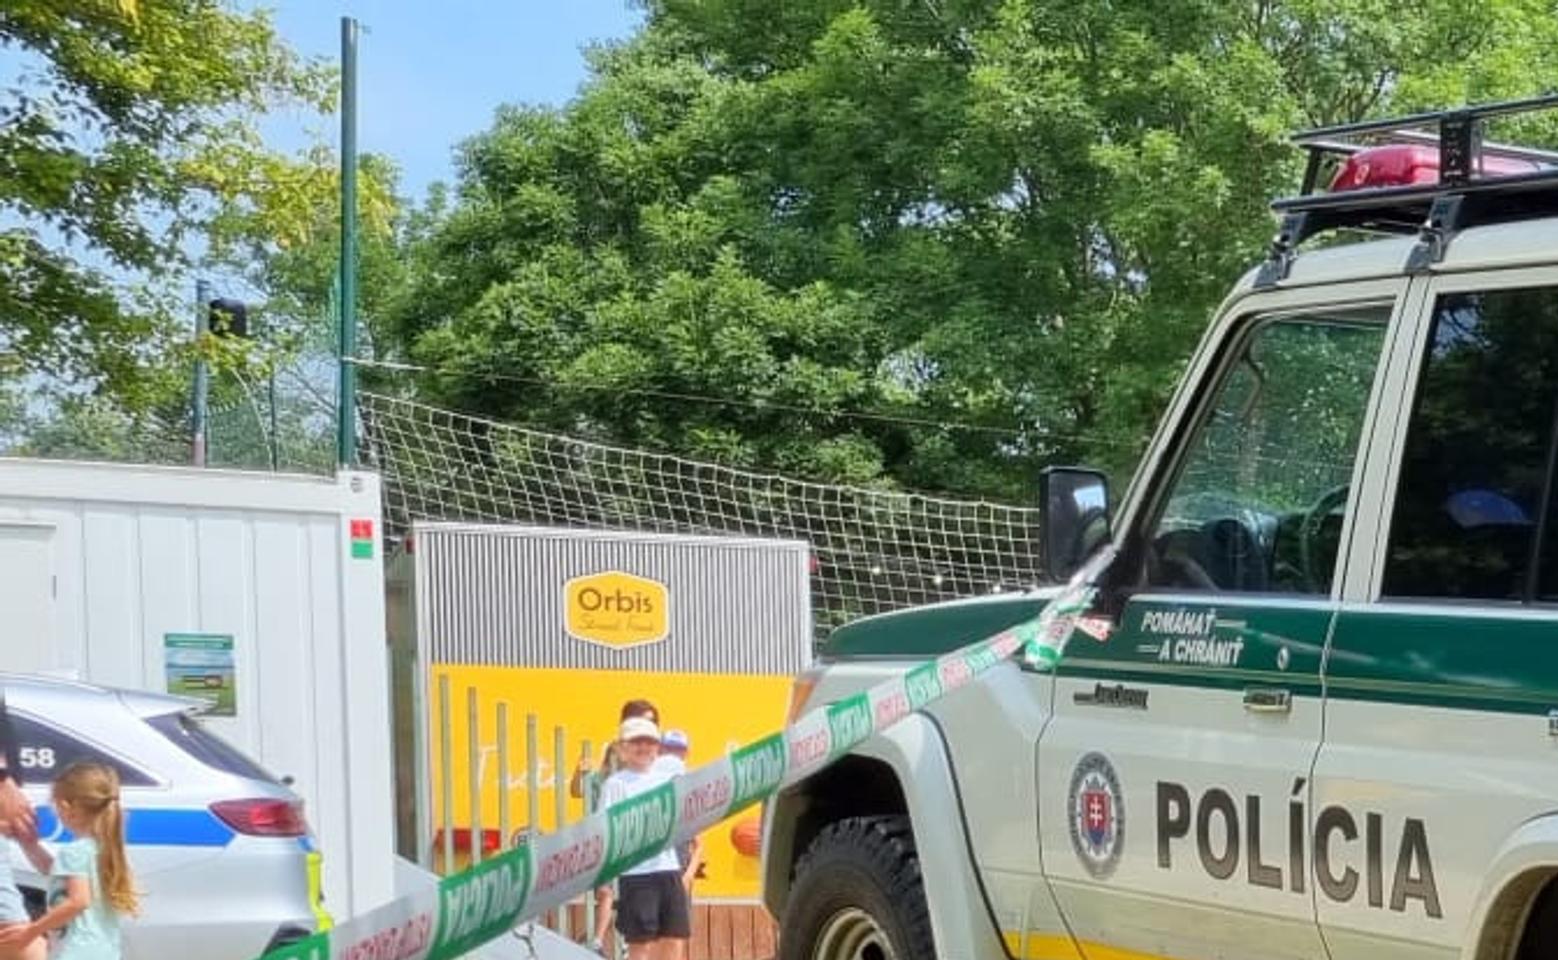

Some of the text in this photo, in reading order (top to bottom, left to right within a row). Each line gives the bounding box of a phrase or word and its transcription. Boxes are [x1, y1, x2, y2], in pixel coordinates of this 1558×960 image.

[577, 587, 654, 614] Orbis
[1141, 607, 1216, 634] POMÁHAŤ
[1159, 634, 1244, 666] A CHRÁNIŤ
[19, 747, 56, 769] 58
[1156, 776, 1444, 920] POLÍCIA
